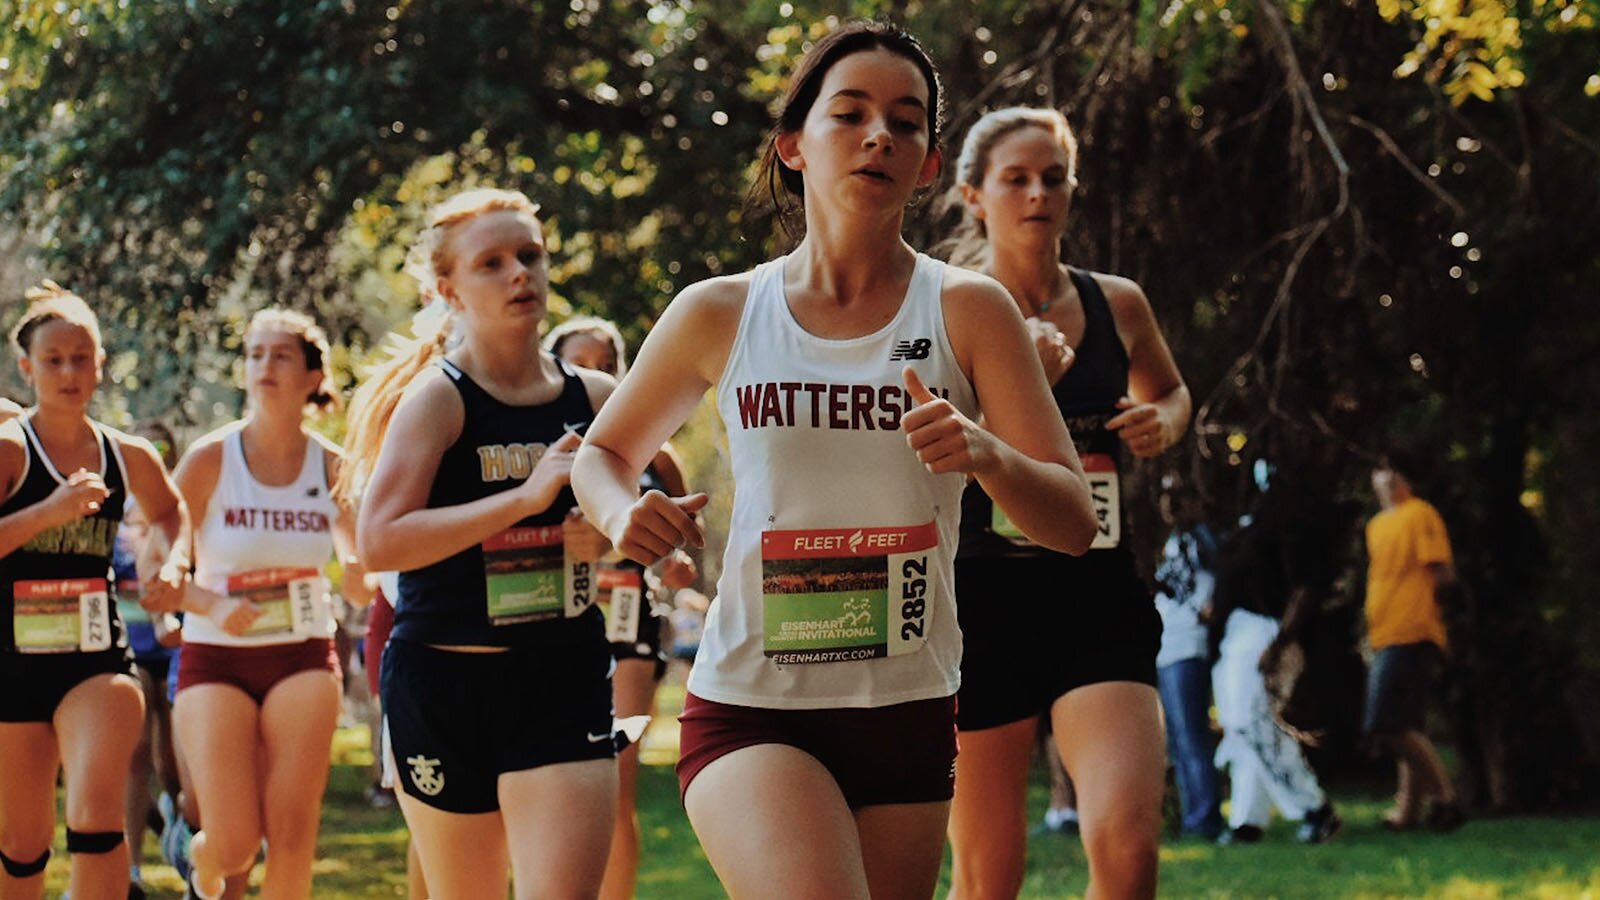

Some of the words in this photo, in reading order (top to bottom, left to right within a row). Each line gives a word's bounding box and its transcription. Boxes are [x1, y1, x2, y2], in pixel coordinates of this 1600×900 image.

[736, 382, 949, 430] WATTERS
[1090, 481, 1110, 536] 2471
[794, 535, 845, 551] FLEET
[867, 532, 908, 548] FEET
[573, 561, 590, 607] 285
[901, 556, 928, 641] 2852
[781, 620, 846, 631] EISENHART
[799, 627, 877, 642] INVITATIONAL
[772, 649, 875, 664] EISENHARTXC.COM
